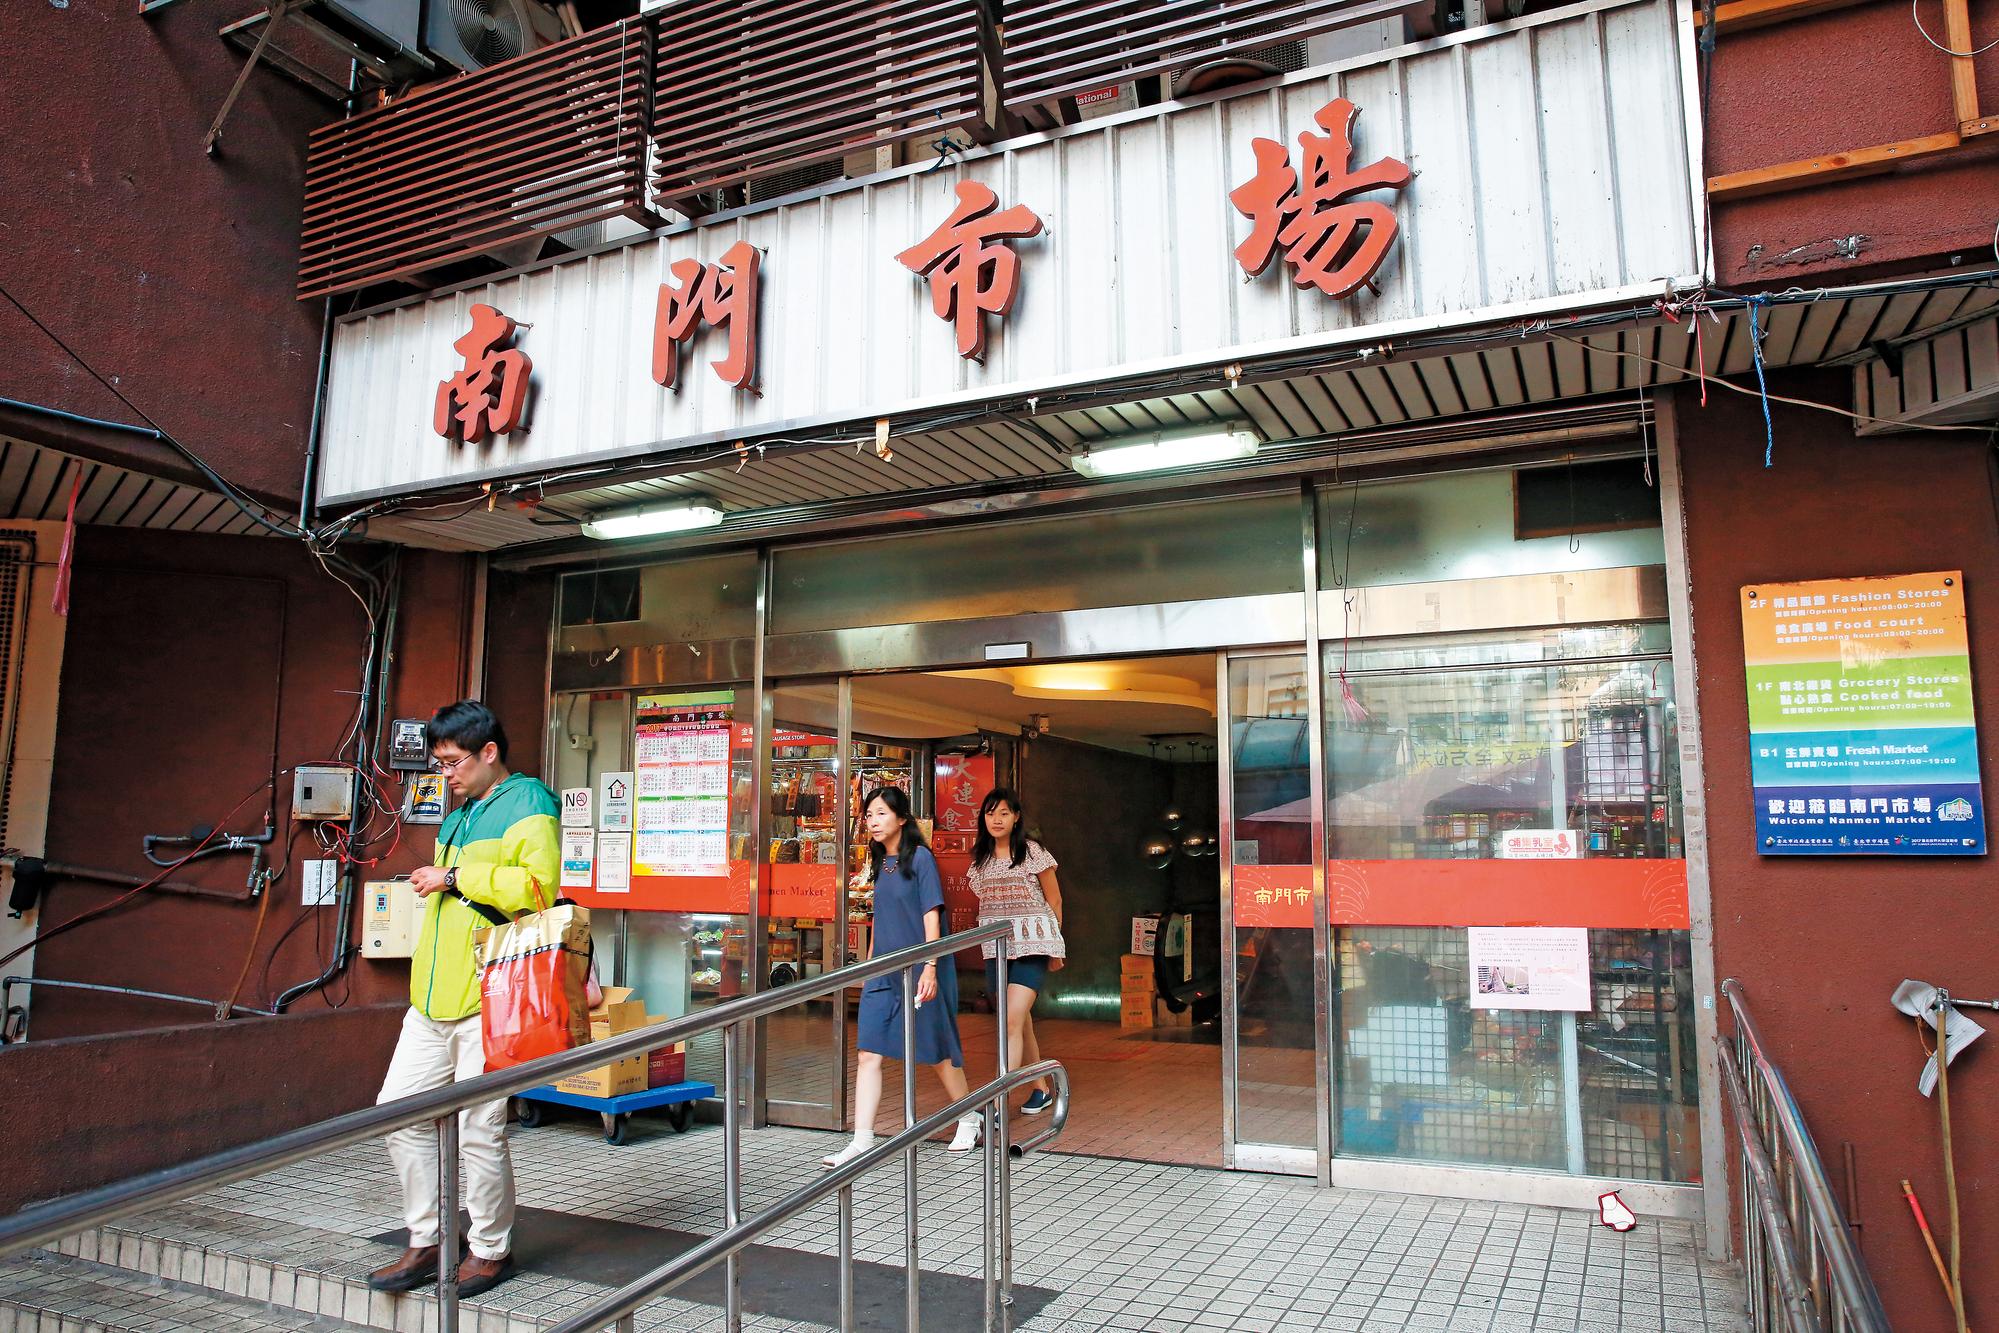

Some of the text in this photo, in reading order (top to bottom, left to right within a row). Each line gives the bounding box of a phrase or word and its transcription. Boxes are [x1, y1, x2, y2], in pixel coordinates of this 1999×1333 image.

[432, 97, 1412, 445] 南門市場
[1750, 599, 1767, 608] 2F
[1832, 592, 1891, 603] Fashion
[1897, 589, 1950, 599] Stores
[1834, 620, 1872, 630] Food
[1879, 616, 1924, 627] court
[1756, 682, 1773, 691] 1F
[1838, 678, 1900, 688] Grocery
[1906, 675, 1959, 685] Stores
[1839, 690, 1899, 701] Cooked
[1906, 688, 1943, 699] food
[1760, 747, 1778, 757] B1
[1845, 745, 1880, 755] Fresh
[1883, 744, 1929, 754] Market
[1768, 797, 1932, 815] 歡迎蒞臨南門市場
[1769, 816, 1932, 825] Welcome Nanmen Market
[790, 886, 823, 897] Market
[1254, 886, 1312, 906] 南門市
